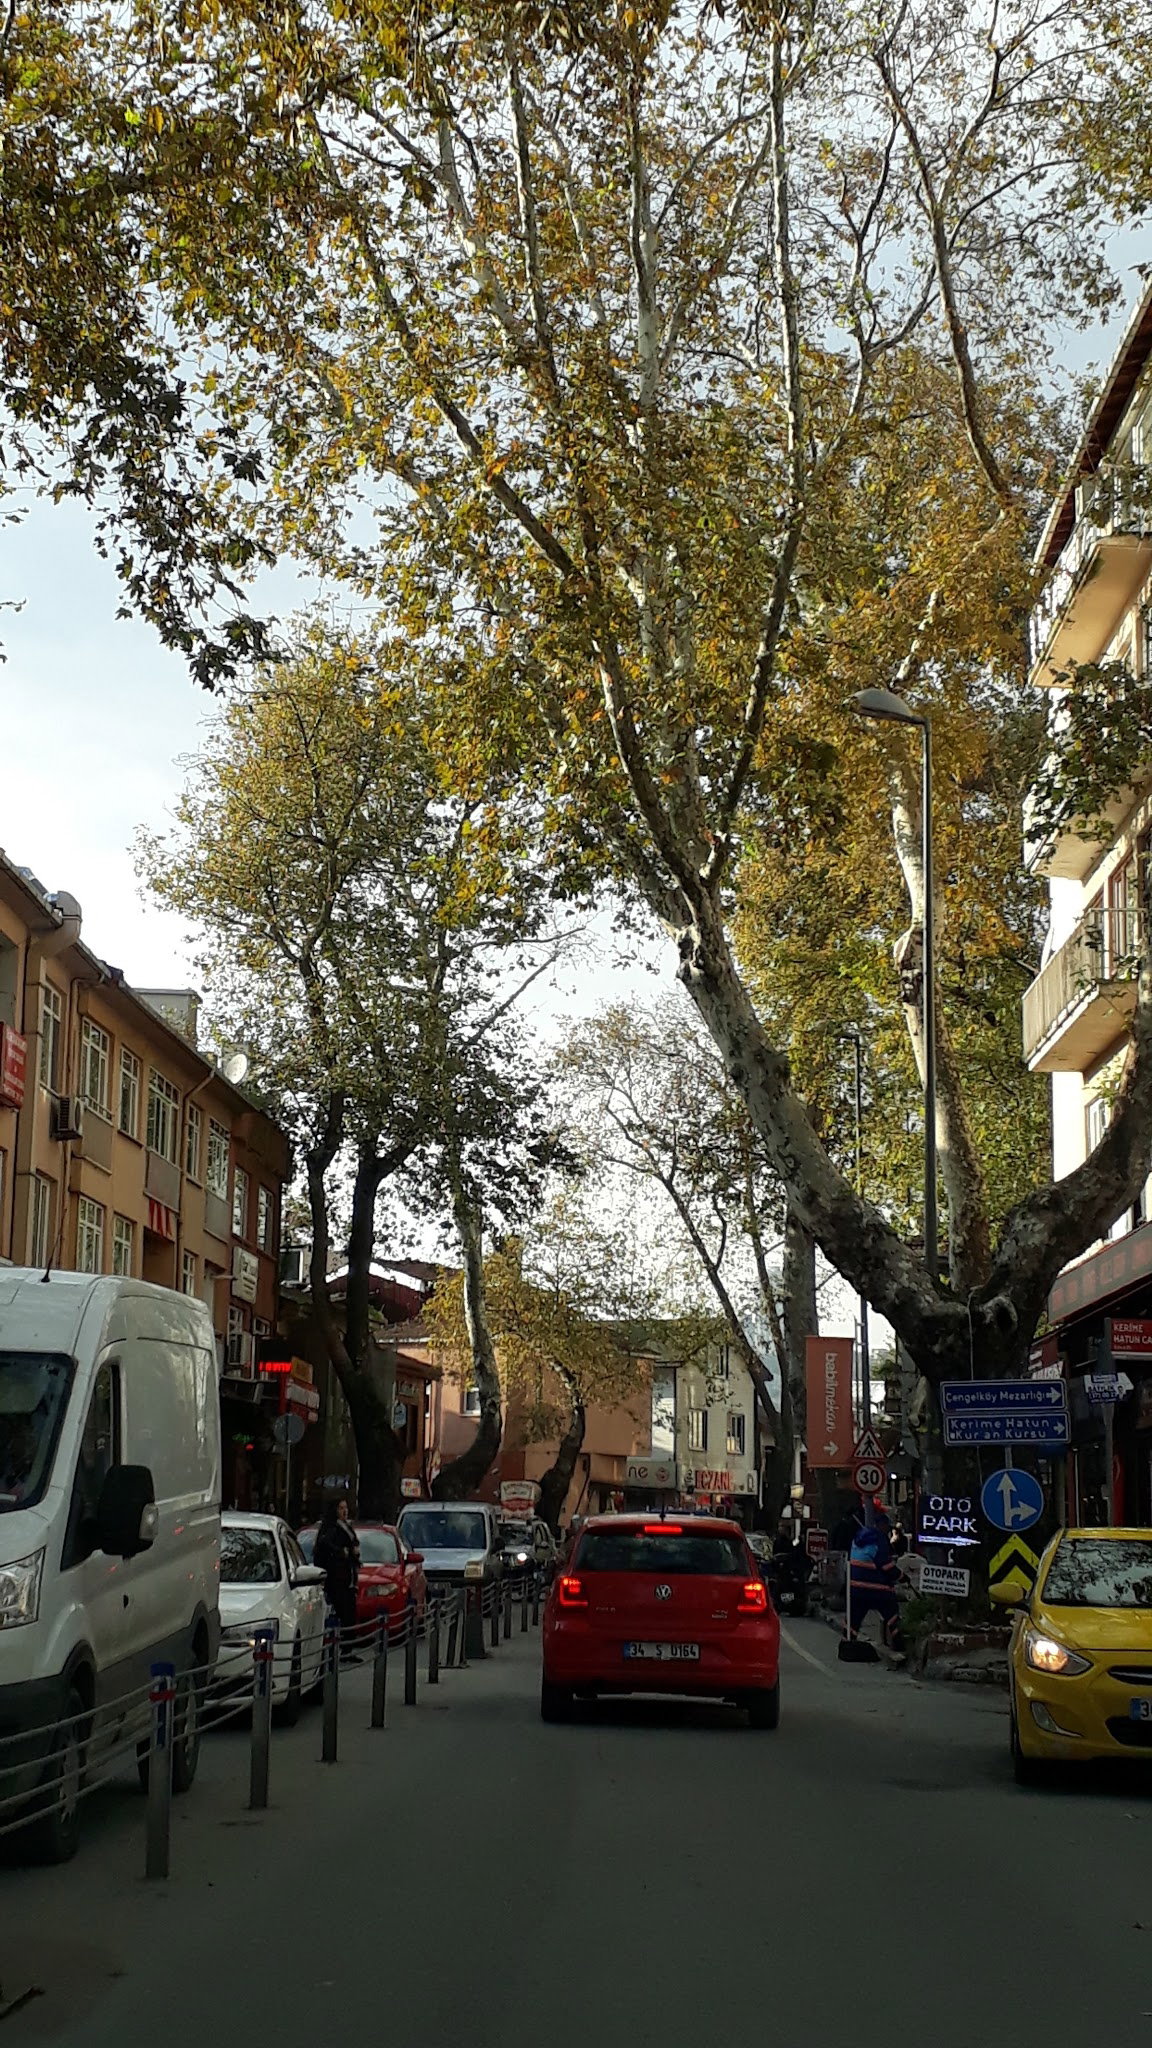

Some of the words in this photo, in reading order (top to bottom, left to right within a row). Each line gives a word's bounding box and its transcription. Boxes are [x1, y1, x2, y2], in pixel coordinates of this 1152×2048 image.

[1113, 1333, 1141, 1344] HATUN
[950, 1419, 1002, 1430] Kerime
[1005, 1418, 1050, 1428] Hatun
[1004, 1429, 1047, 1439] Kursu
[859, 1469, 879, 1486] 30
[929, 1496, 972, 1513] OTO
[922, 1514, 979, 1533] PARK
[923, 1567, 965, 1580] OTOPARK
[631, 1644, 645, 1656] 34
